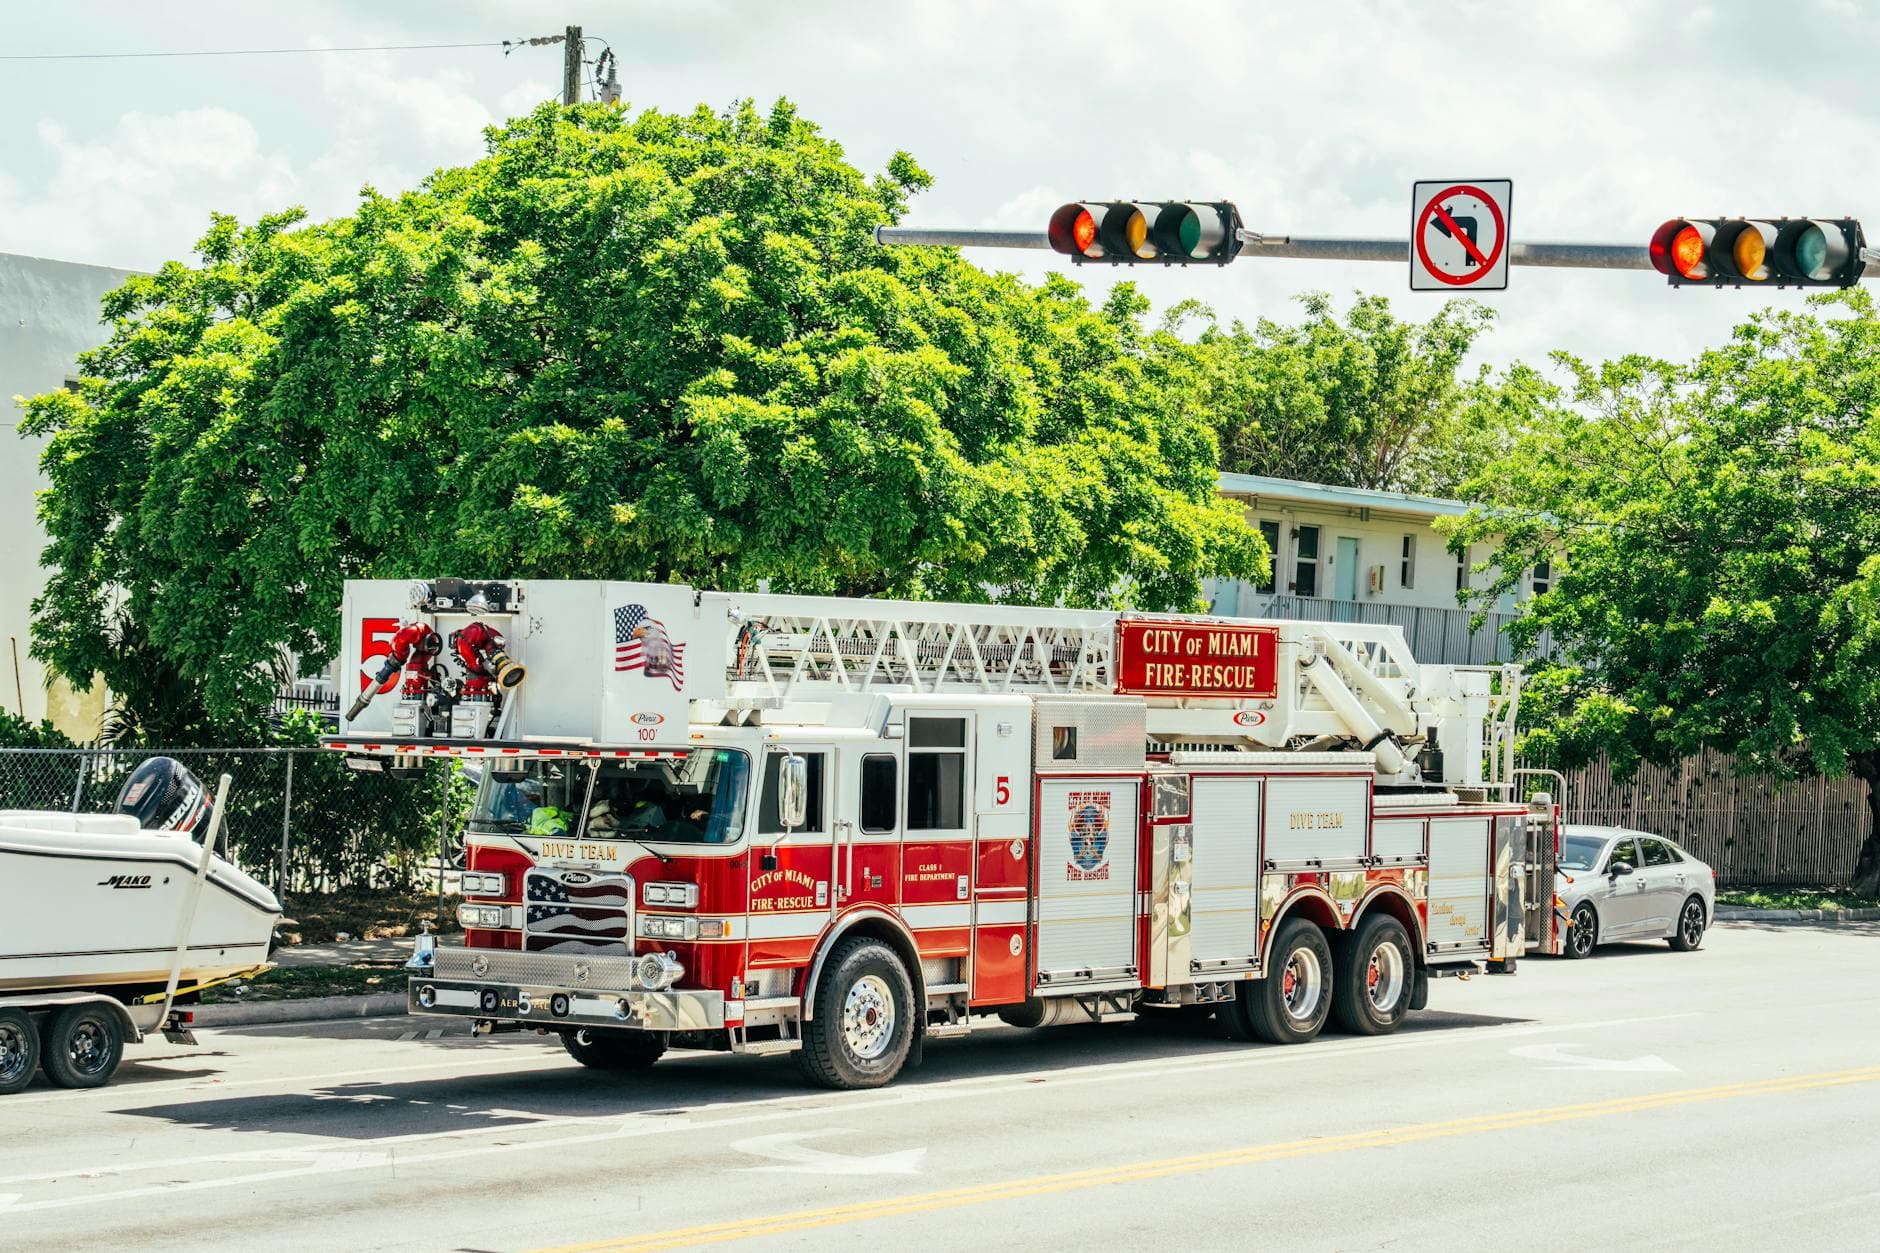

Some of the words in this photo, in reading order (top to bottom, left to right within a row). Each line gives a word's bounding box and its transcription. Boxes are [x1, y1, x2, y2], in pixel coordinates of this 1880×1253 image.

[1142, 629, 1183, 654] CITY
[1186, 638, 1203, 656] OF
[1208, 632, 1260, 657] MIAMI
[361, 618, 400, 694] 5
[997, 776, 1010, 805] 5
[1290, 812, 1313, 830] DIVE
[1317, 812, 1344, 829] TEAM
[542, 842, 575, 859] DIVE
[580, 844, 617, 861] TEAM
[904, 873, 918, 882] FIRE
[919, 872, 956, 881] DEPARTMENT
[918, 863, 938, 872] CLASS
[1067, 861, 1082, 881] FIRE
[1083, 862, 1110, 881] RESCUE
[98, 875, 152, 889] MAKO
[564, 872, 589, 884] Pierce
[751, 871, 773, 892] CITY
[773, 871, 783, 882] OF
[785, 869, 815, 890] MIAMI
[518, 991, 532, 1014] 5
